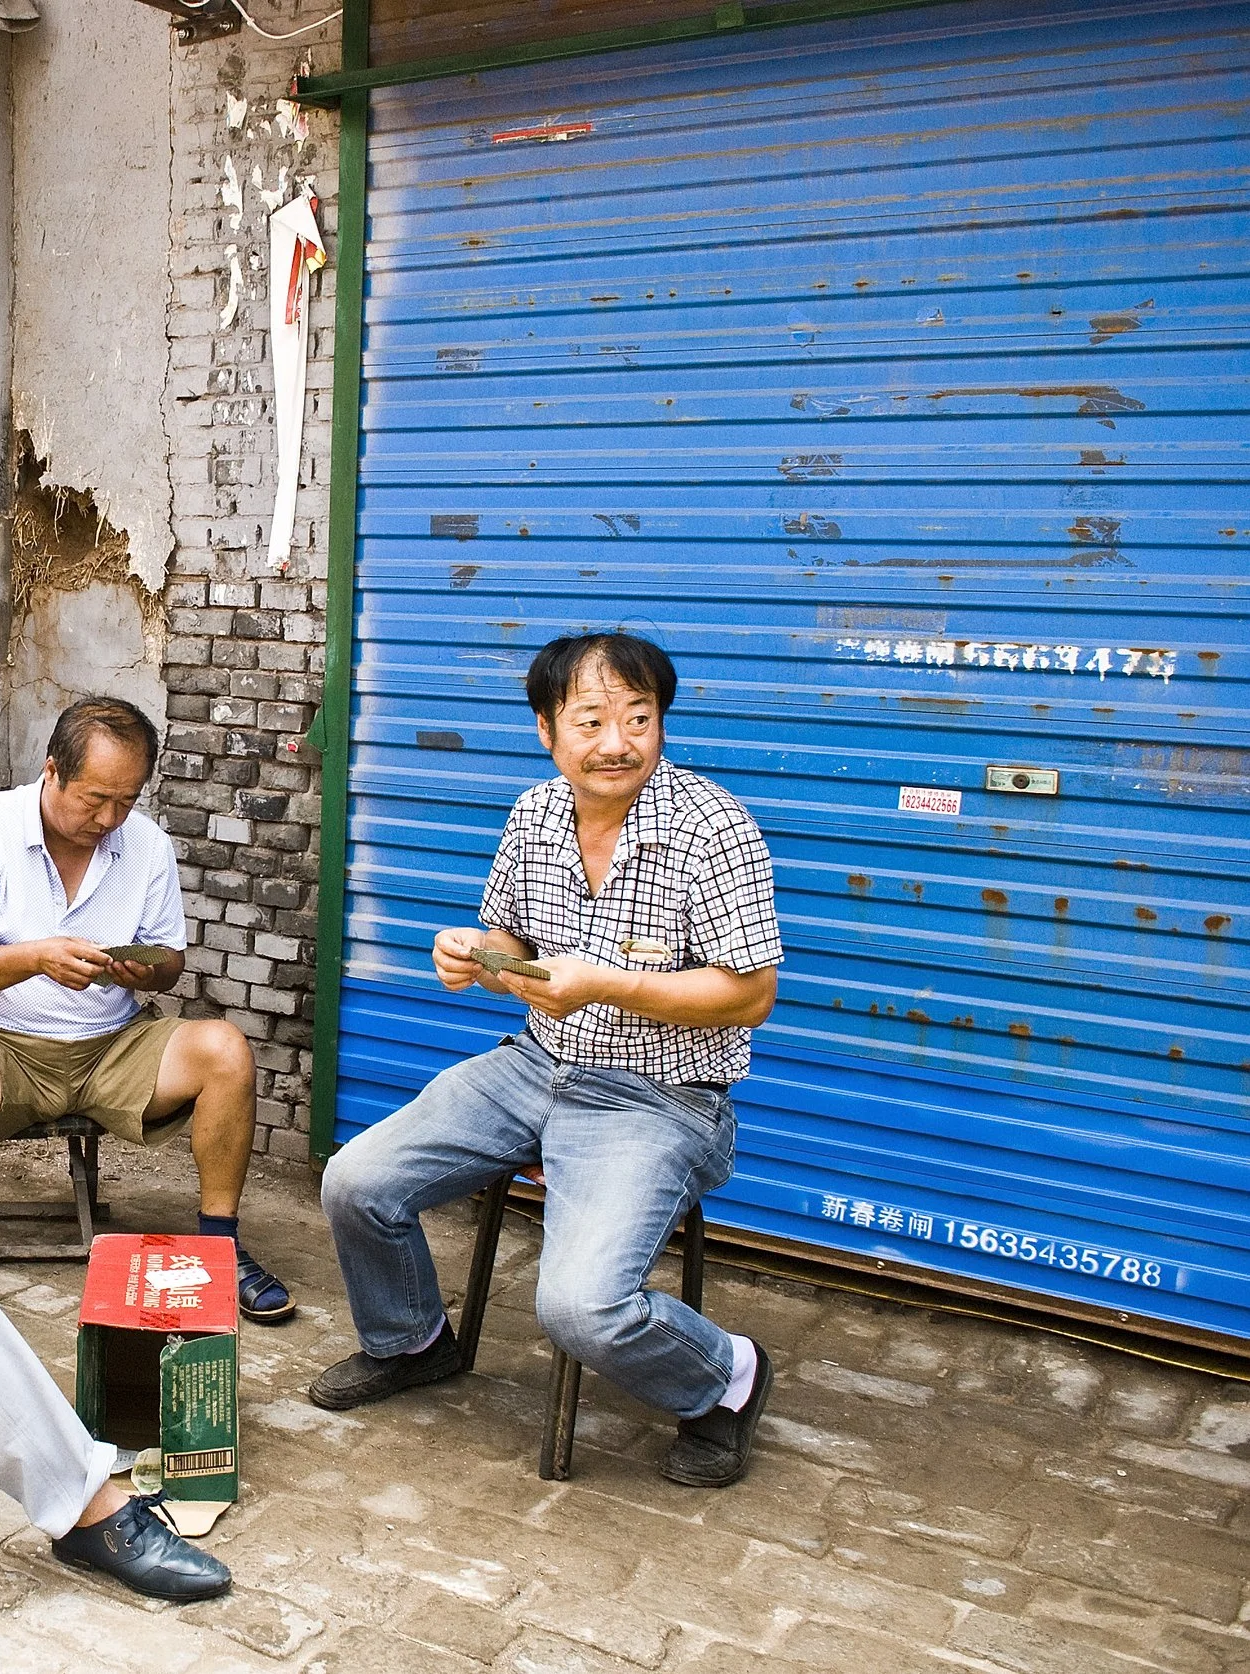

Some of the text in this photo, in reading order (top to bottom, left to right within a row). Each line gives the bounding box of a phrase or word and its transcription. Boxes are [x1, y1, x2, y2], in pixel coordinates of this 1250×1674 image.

[901, 794, 958, 813] 18234422566
[821, 1194, 1162, 1288] 新春卷闸 15635435788
[165, 1254, 204, 1309] 农山泉
